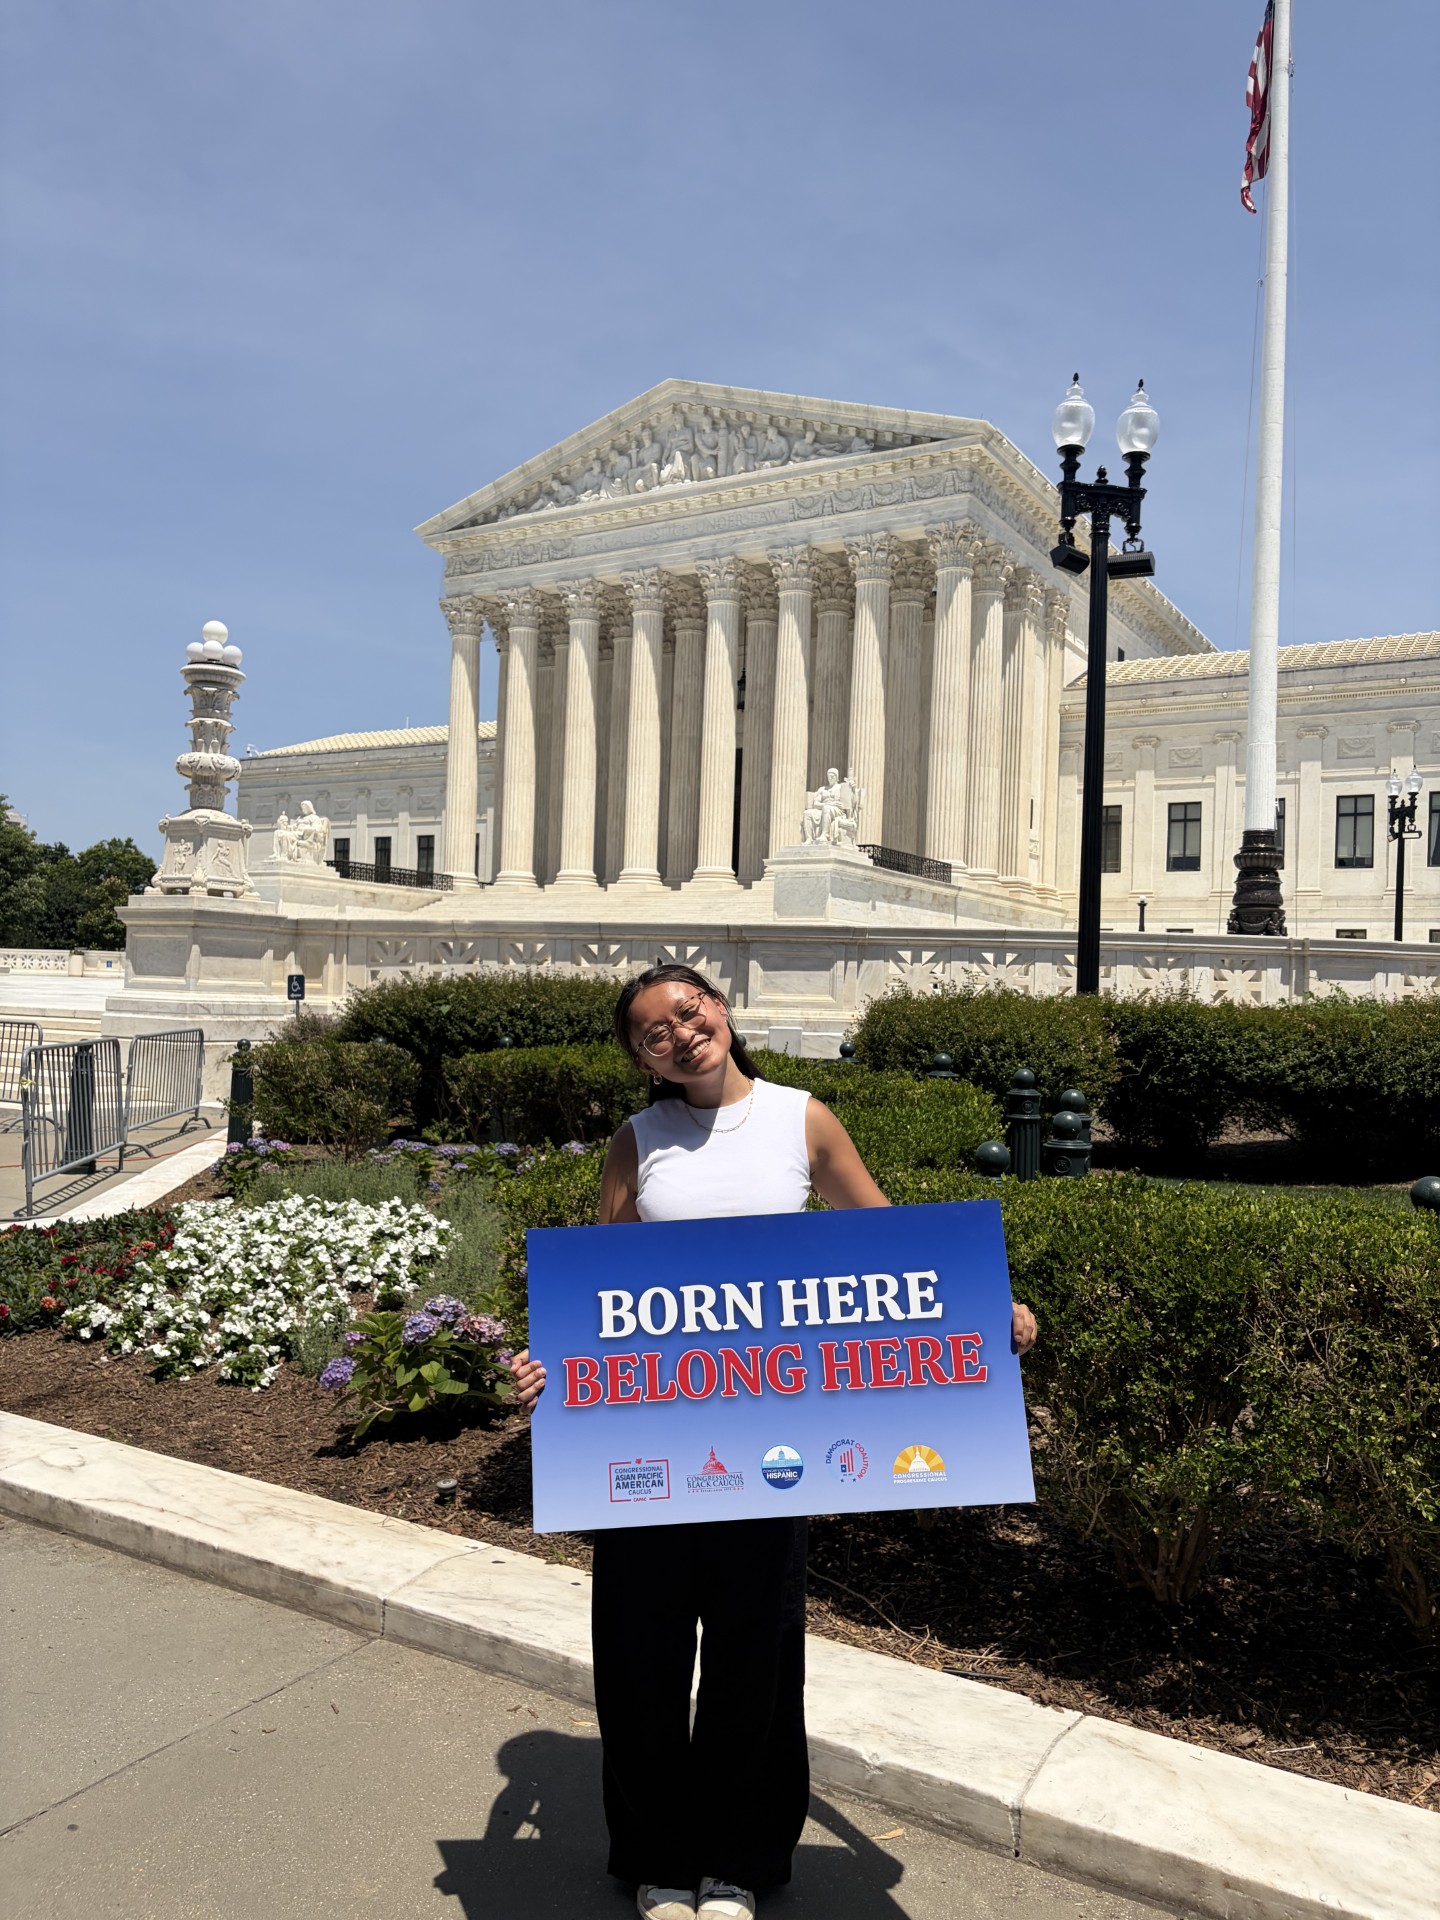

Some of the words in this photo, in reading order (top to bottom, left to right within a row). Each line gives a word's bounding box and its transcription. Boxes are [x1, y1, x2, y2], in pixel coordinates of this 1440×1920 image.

[696, 514, 743, 533] UNDER
[750, 508, 778, 524] LAW
[598, 1281, 764, 1338] BORN
[777, 1270, 943, 1327] HERE
[563, 1344, 807, 1407] BELONG
[818, 1332, 988, 1391] HERE
[825, 1438, 855, 1464] DEMOCRAT
[854, 1442, 869, 1480] COALITION
[614, 1465, 663, 1474] CONGRESSIONAL
[615, 1474, 636, 1482] ASIAN
[637, 1472, 663, 1480] PACIFIC
[686, 1473, 744, 1482] CONGRESSIONAL
[766, 1471, 798, 1479] HISPANIC
[893, 1471, 947, 1479] CONGRESSIONAL
[615, 1479, 664, 1490] AMERICAN
[687, 1480, 712, 1488] BLACK
[712, 1479, 745, 1487] CAUCUS
